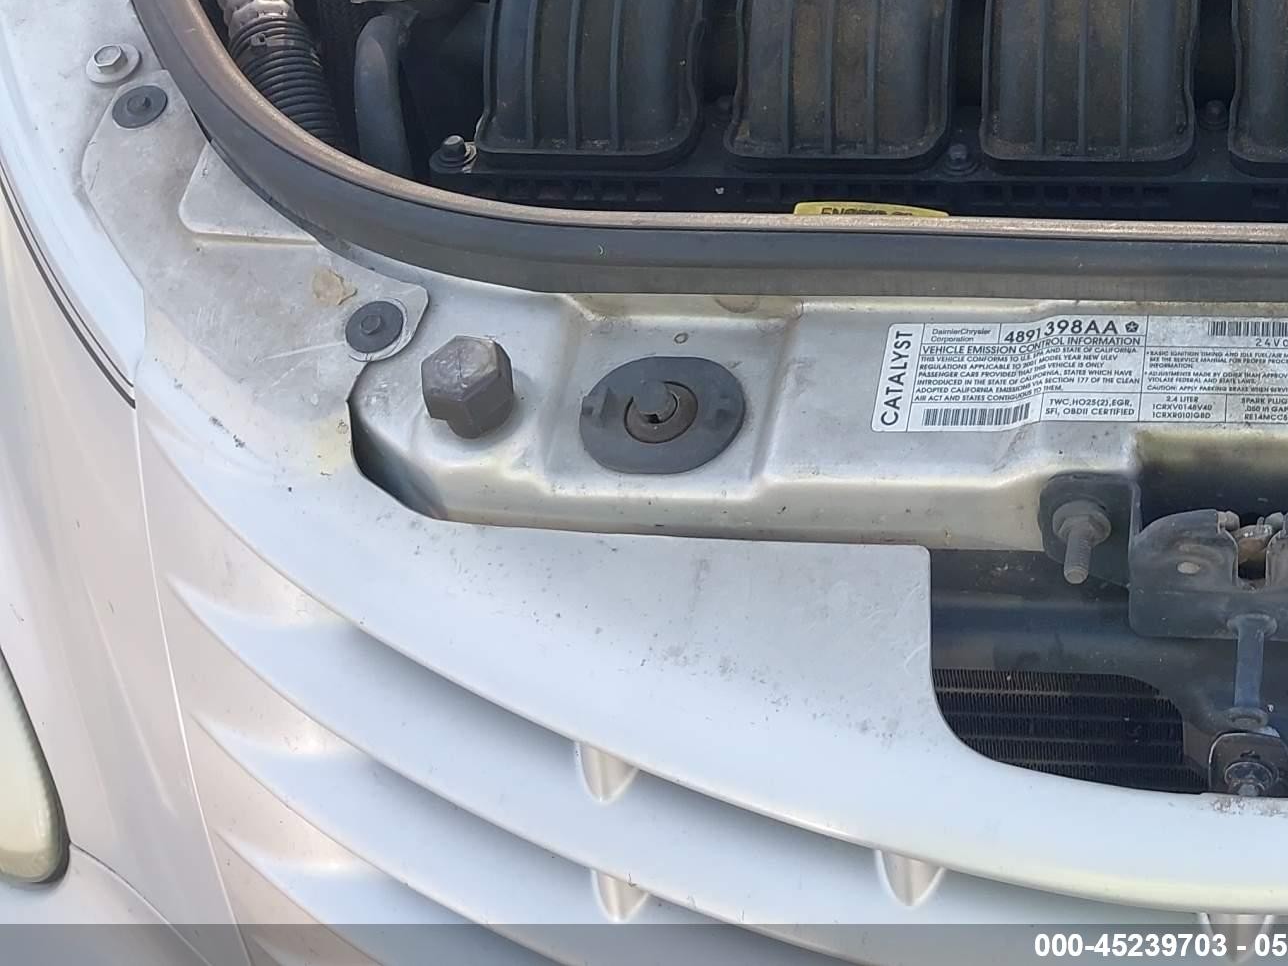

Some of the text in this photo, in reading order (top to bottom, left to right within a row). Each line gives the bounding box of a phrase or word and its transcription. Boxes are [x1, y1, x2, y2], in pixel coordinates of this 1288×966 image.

[932, 328, 991, 336] DaimlerChrysler
[923, 337, 1141, 354] VEHICLE EMISSION CONTROL INFORMATION
[1038, 355, 1062, 363] MODEL
[881, 331, 913, 426] CATALYST
[1090, 407, 1135, 415] CERTIFIED
